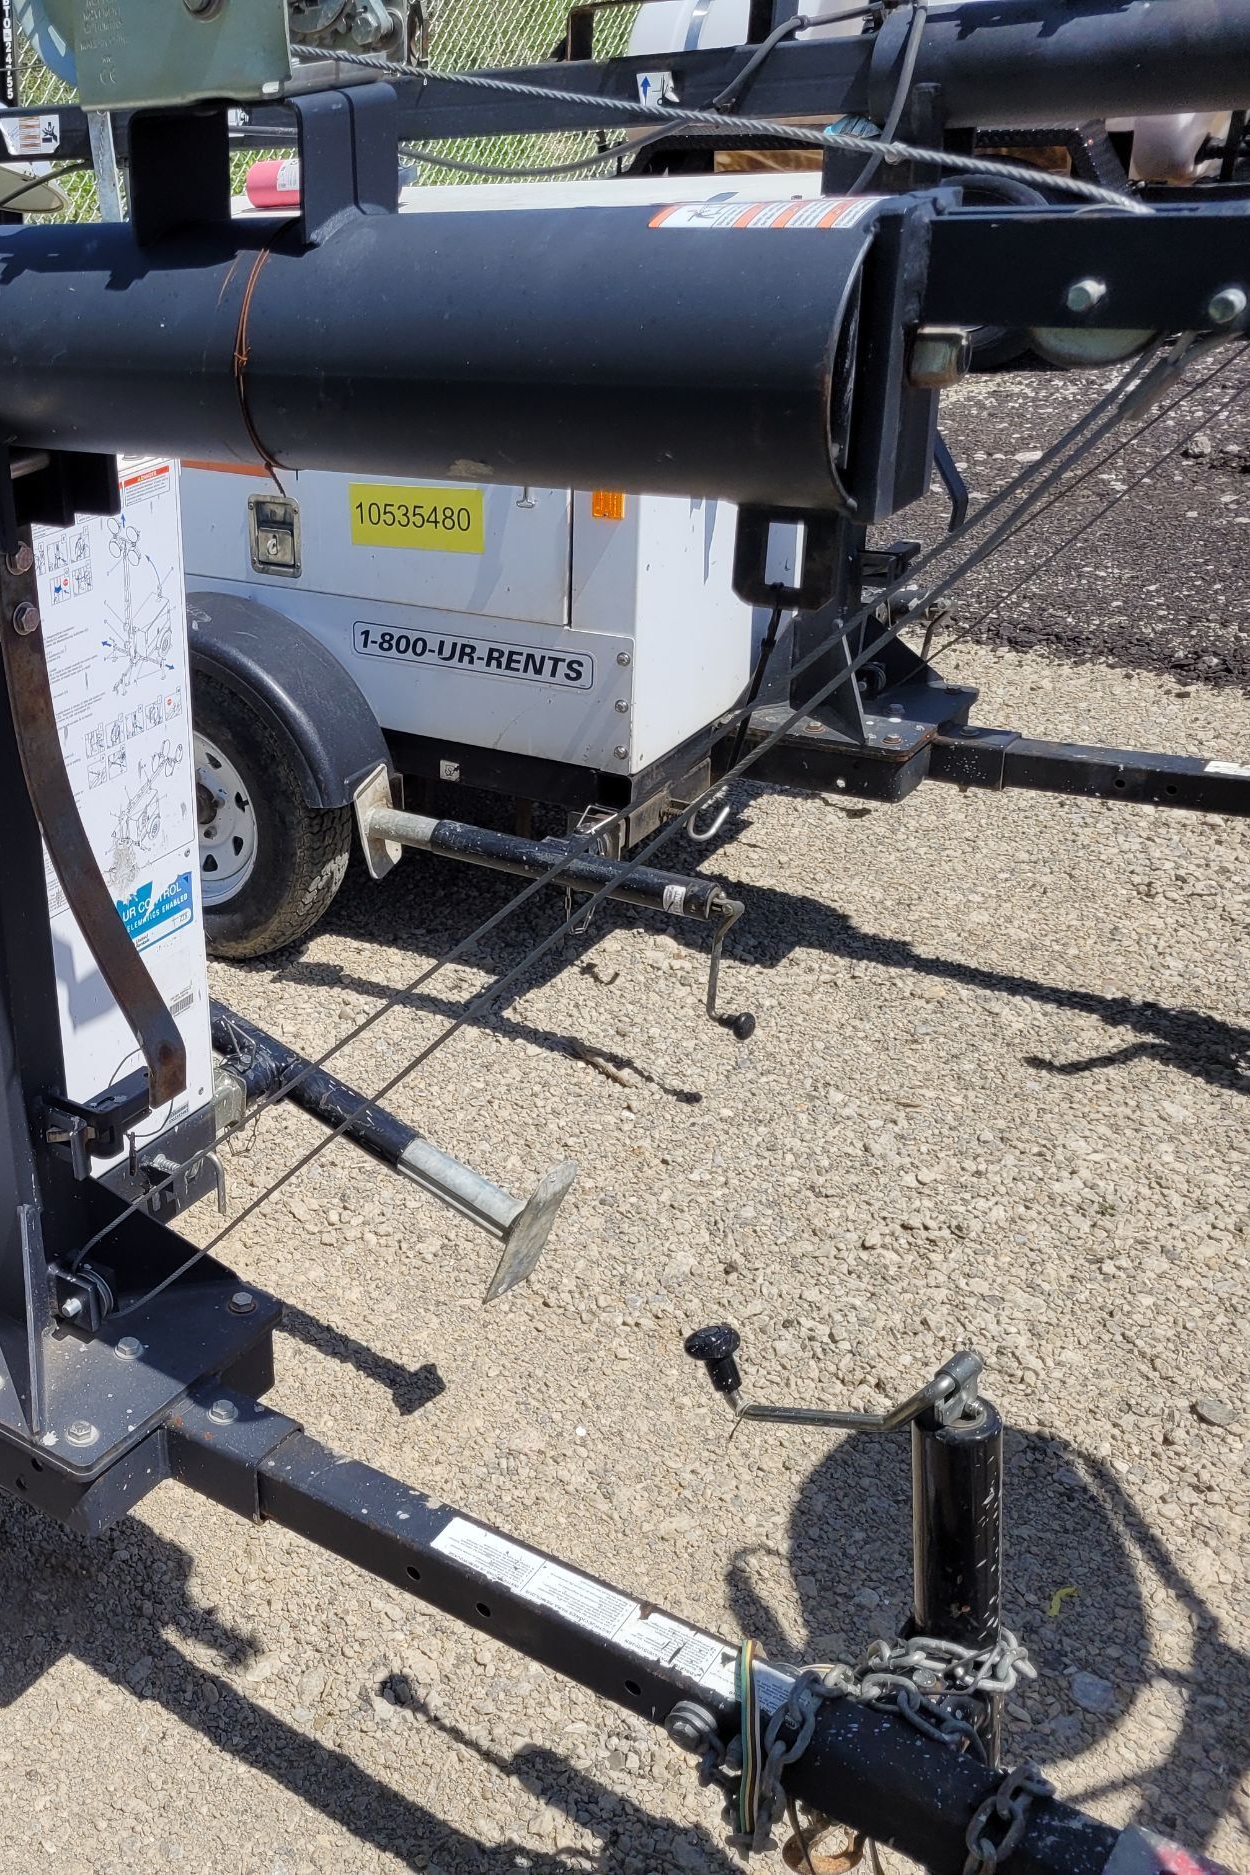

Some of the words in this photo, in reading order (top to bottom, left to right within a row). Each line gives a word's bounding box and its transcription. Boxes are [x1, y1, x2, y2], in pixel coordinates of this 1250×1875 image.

[355, 501, 471, 532] 10535480
[360, 629, 584, 682] 1-800-UR-RENTS
[162, 893, 188, 913] ENABLED
